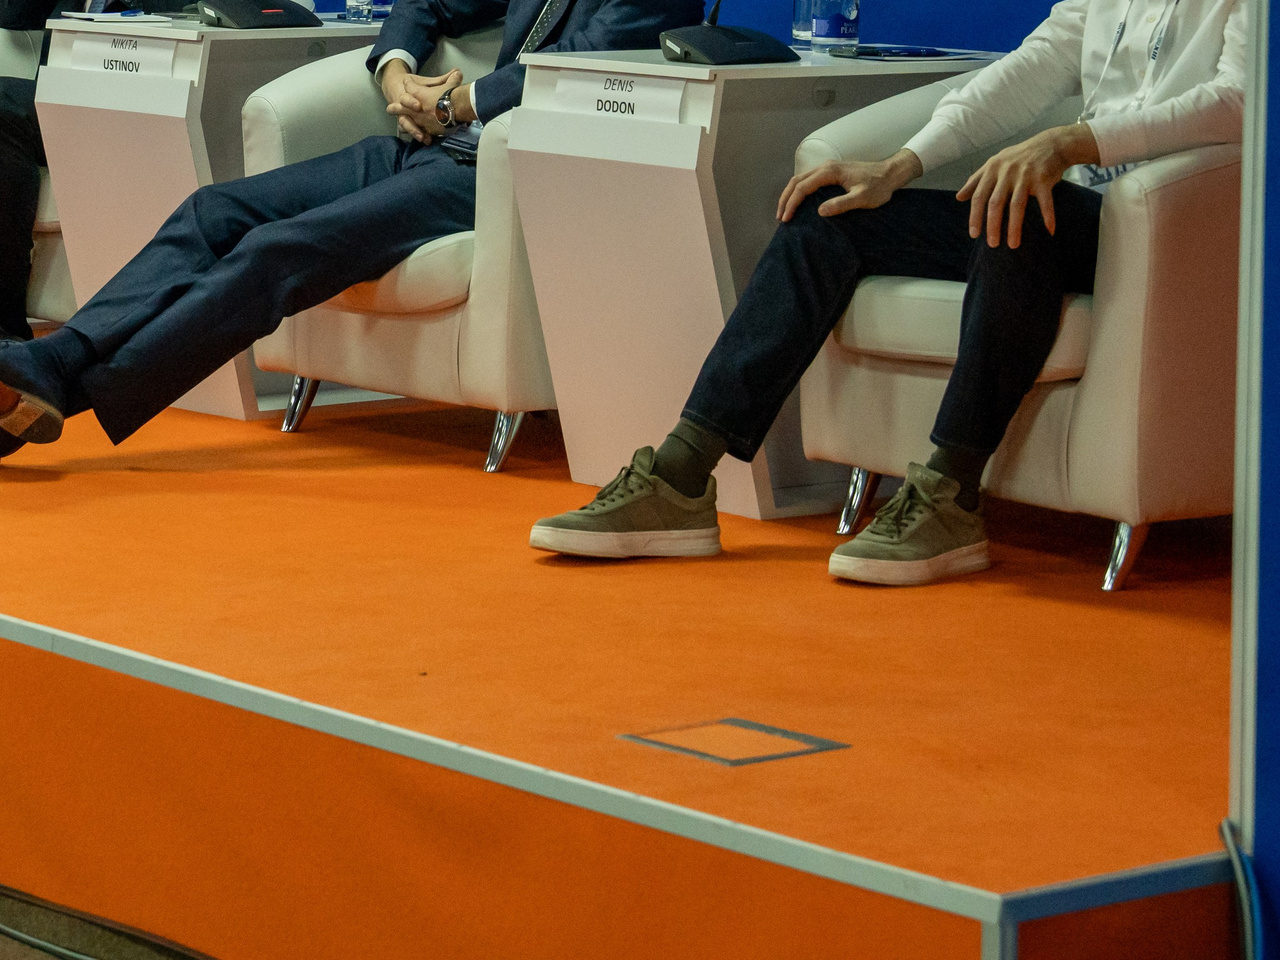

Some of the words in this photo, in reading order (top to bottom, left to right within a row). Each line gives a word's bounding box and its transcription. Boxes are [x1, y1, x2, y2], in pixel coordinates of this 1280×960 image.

[111, 38, 138, 51] NIKITA
[103, 58, 140, 73] USTINOV
[603, 78, 635, 93] DENIS
[596, 99, 635, 115] DODON
